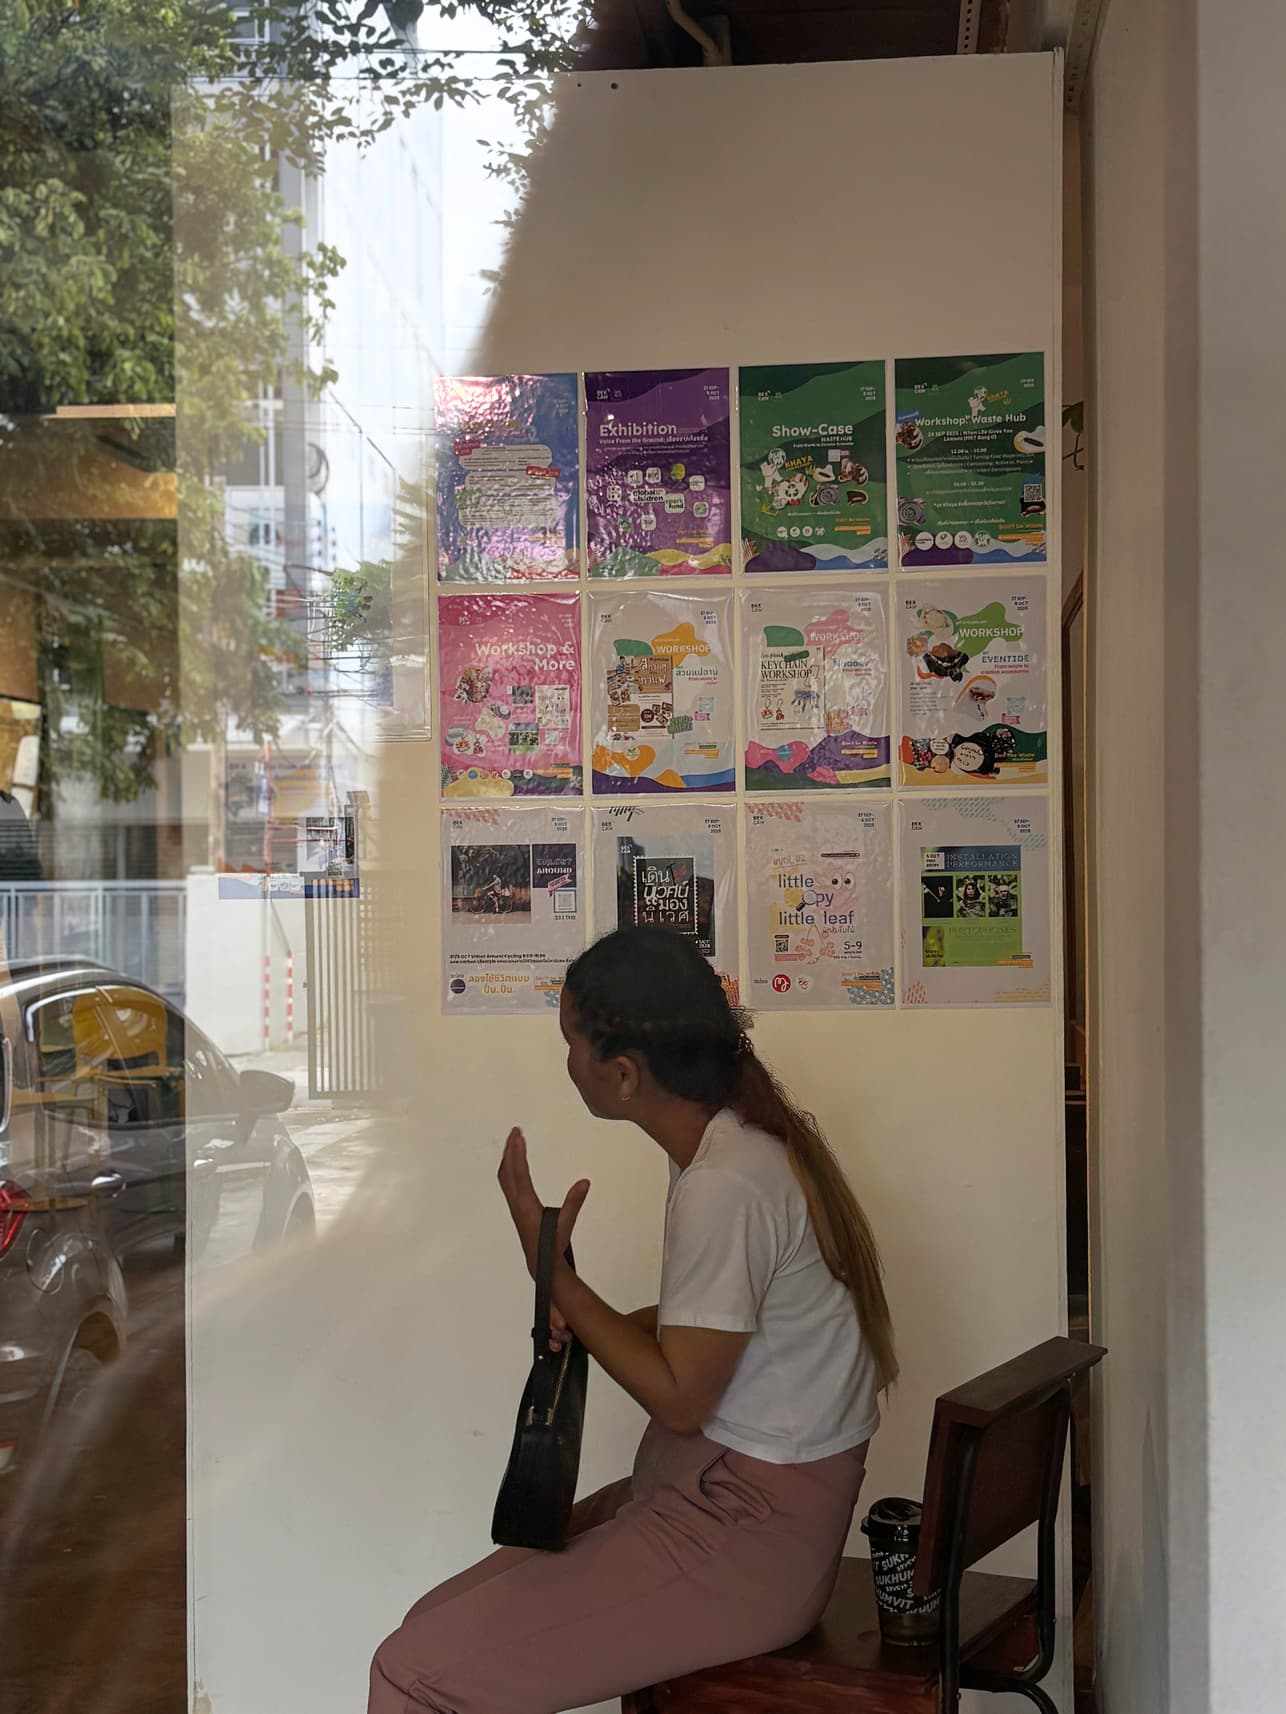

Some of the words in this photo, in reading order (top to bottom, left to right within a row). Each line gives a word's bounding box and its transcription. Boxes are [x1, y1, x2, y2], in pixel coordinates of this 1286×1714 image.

[971, 416, 1002, 424] Waste
[1005, 414, 1026, 422] Hub
[600, 421, 677, 437] Exhibition
[772, 424, 853, 437] Show-Case
[784, 456, 814, 468] KHAYA
[960, 626, 1024, 638] WORKSHOP
[475, 642, 556, 658] Workshop
[562, 641, 575, 654] &
[656, 643, 711, 654] WORKSHOP
[534, 659, 576, 671] More
[761, 659, 808, 670] KEYCHAIN
[982, 654, 1029, 664] EVENTIDE
[760, 668, 813, 679] WORKSHOP
[946, 852, 1017, 861] INSTALLATION
[946, 860, 1017, 868] PERFORMANCE
[536, 867, 573, 875] AROUND
[641, 865, 670, 883] เดิน
[778, 874, 815, 889] little
[658, 899, 689, 911] มอง
[642, 905, 689, 923] นิเวศ
[778, 911, 815, 926] little
[823, 910, 855, 925] leaf
[844, 940, 862, 950] 5-9
